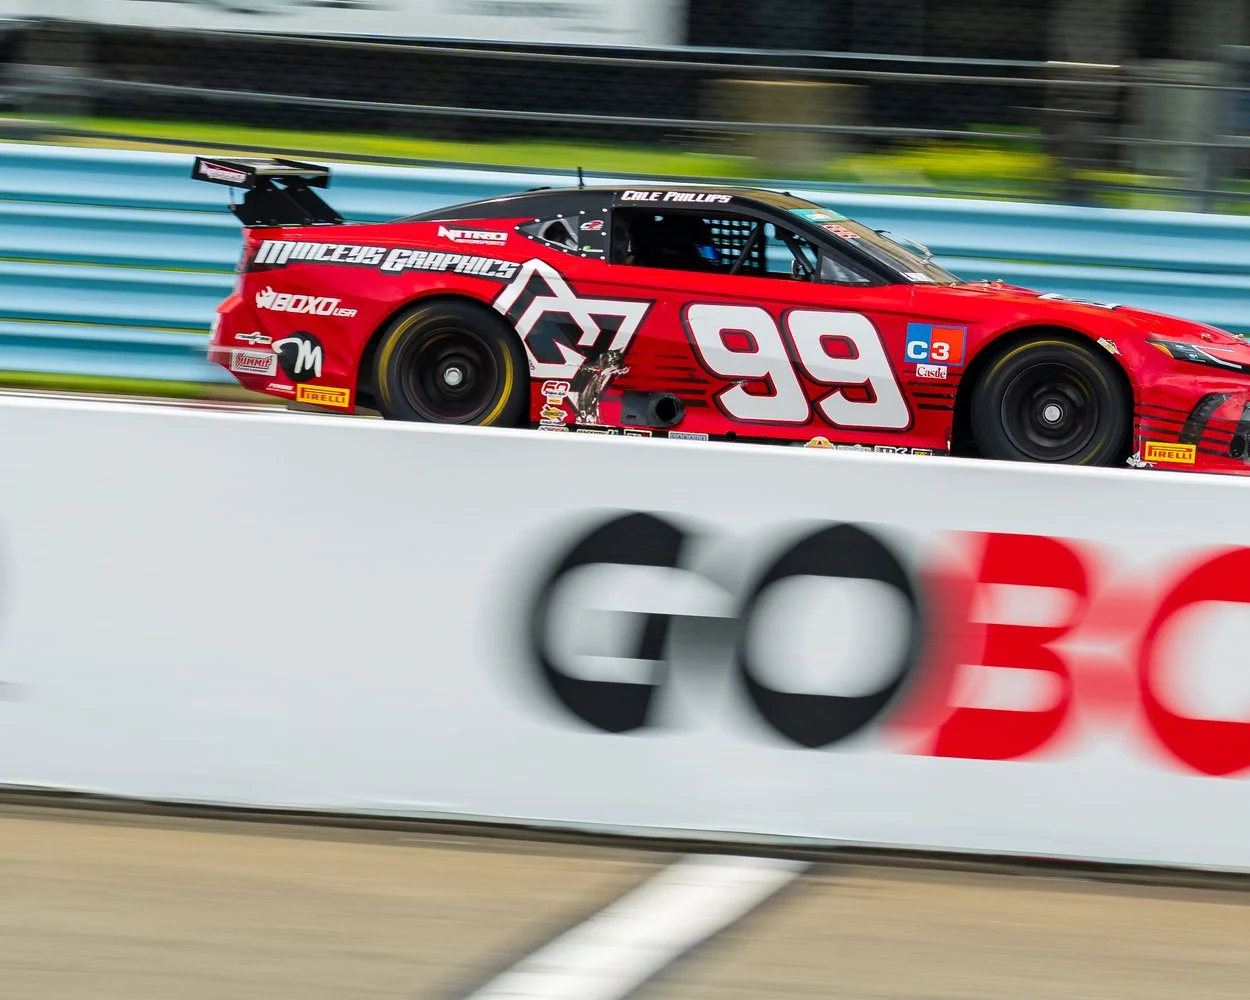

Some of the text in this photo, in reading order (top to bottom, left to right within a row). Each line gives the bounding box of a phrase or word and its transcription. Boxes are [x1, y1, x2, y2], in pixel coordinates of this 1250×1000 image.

[621, 191, 732, 203] CALE PHILLIPS
[437, 225, 508, 242] NITRO
[254, 240, 521, 279] MINCEYS GRAPHICS
[271, 292, 358, 317] BOXO USA
[907, 340, 950, 360] C3
[688, 303, 910, 429] 99
[917, 367, 945, 378] Castle
[300, 387, 346, 403] PIRELLI
[1148, 445, 1192, 459] PIRELLI
